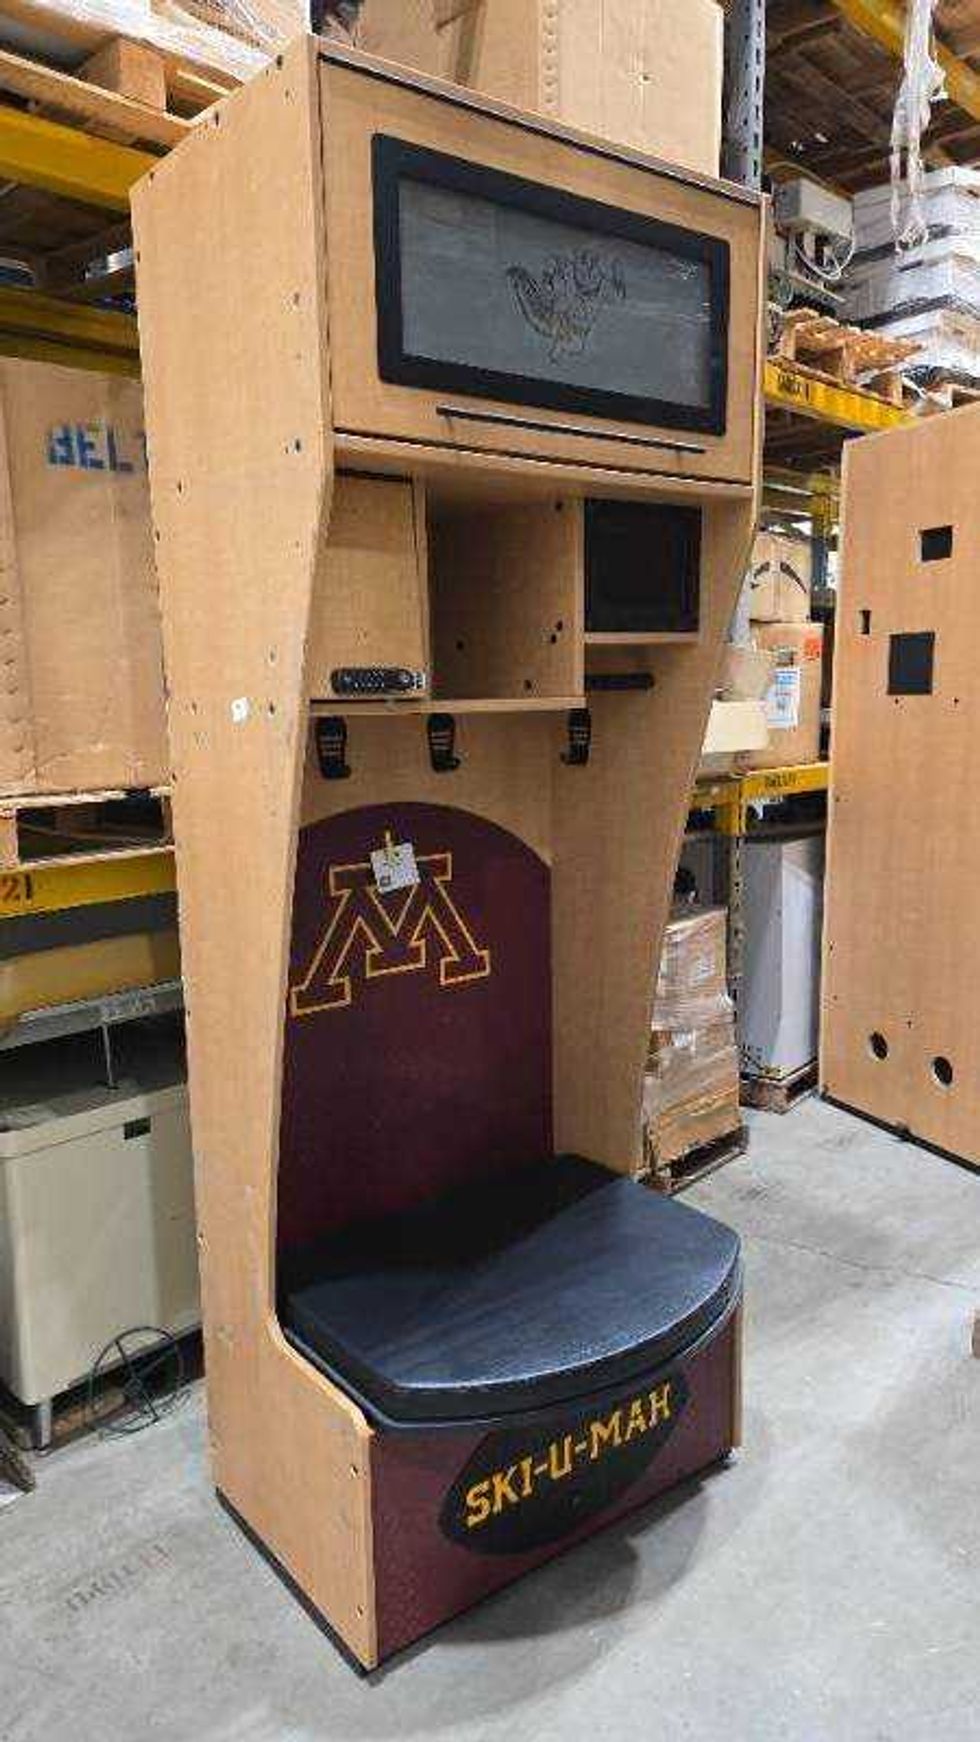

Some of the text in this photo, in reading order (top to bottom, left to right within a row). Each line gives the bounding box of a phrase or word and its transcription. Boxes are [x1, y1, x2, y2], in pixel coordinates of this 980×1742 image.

[47, 424, 146, 472] BEL
[290, 852, 490, 1016] M
[465, 1381, 672, 1528] SKI-U-MAH
